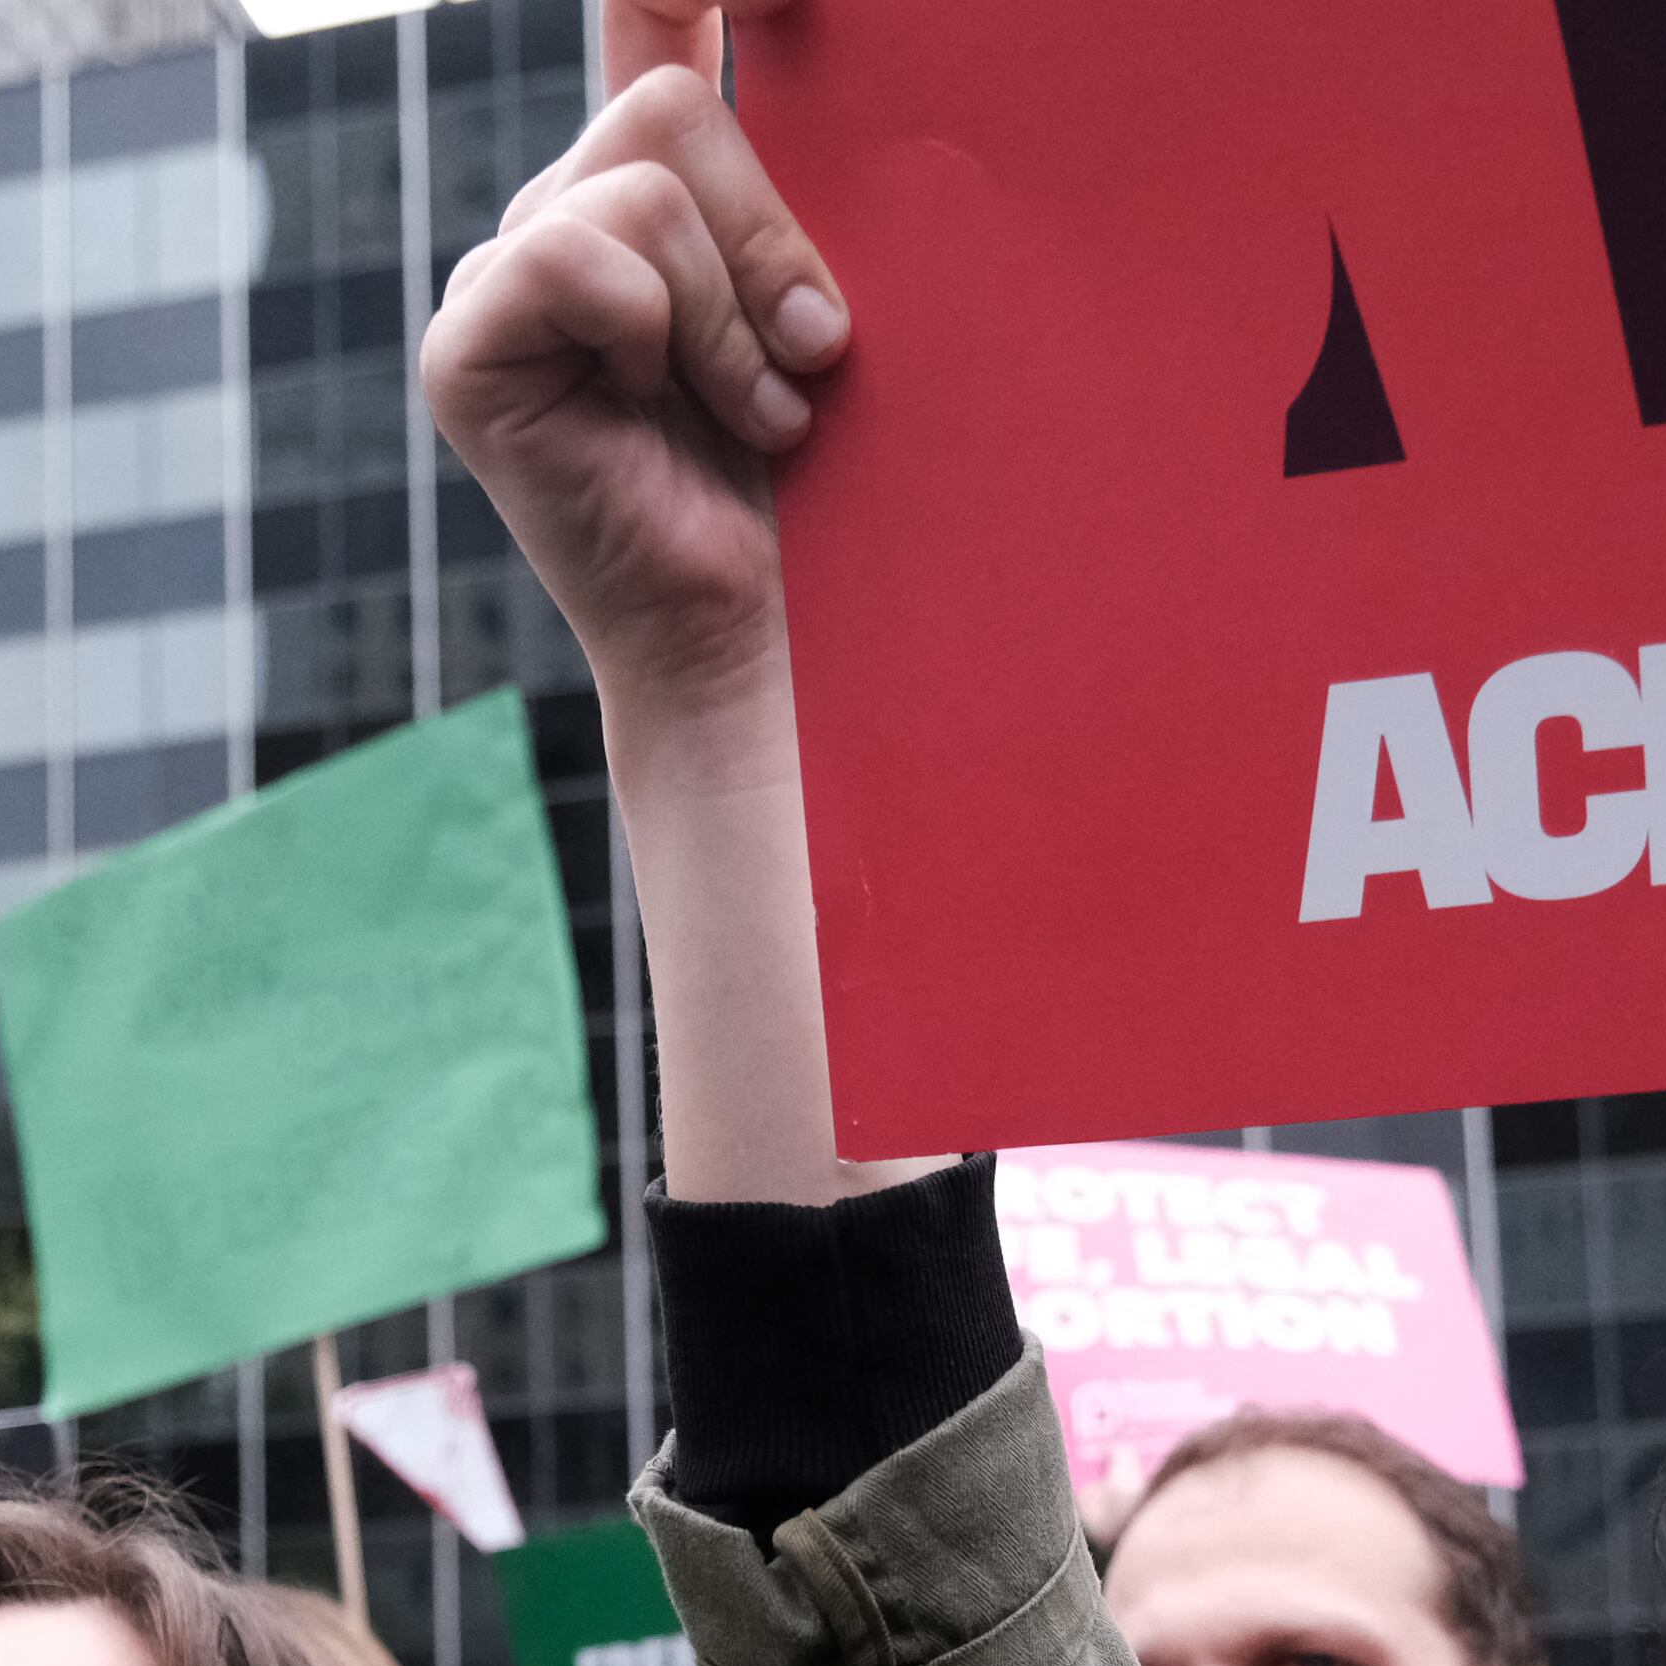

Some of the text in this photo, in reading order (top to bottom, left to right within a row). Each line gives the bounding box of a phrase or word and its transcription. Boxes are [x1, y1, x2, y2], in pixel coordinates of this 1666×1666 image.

[993, 1163, 1326, 1238] ROTECT
[1130, 1227, 1425, 1303] LEGAL
[1015, 1287, 1401, 1359] ORTION
